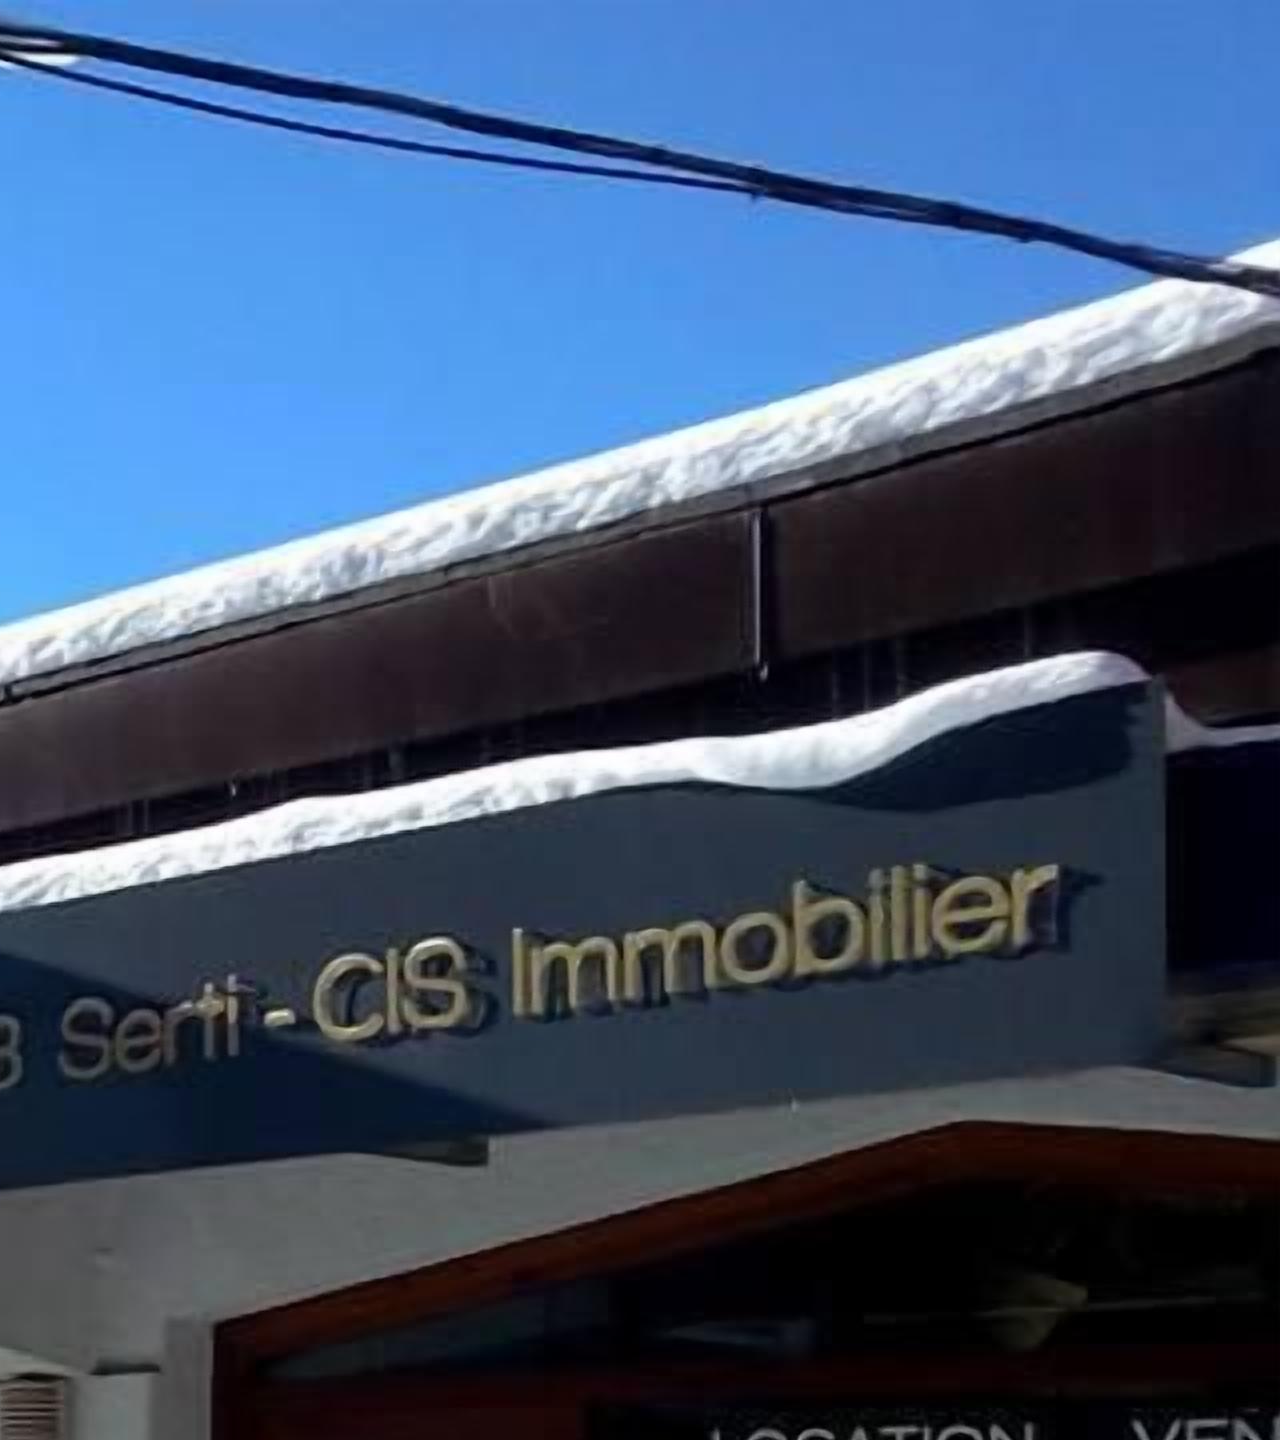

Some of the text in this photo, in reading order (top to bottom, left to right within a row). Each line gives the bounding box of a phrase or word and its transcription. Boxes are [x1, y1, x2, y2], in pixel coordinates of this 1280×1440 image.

[58, 974, 241, 1082] Serti
[311, 934, 466, 1043] CIS
[512, 862, 1061, 1020] Immobilier
